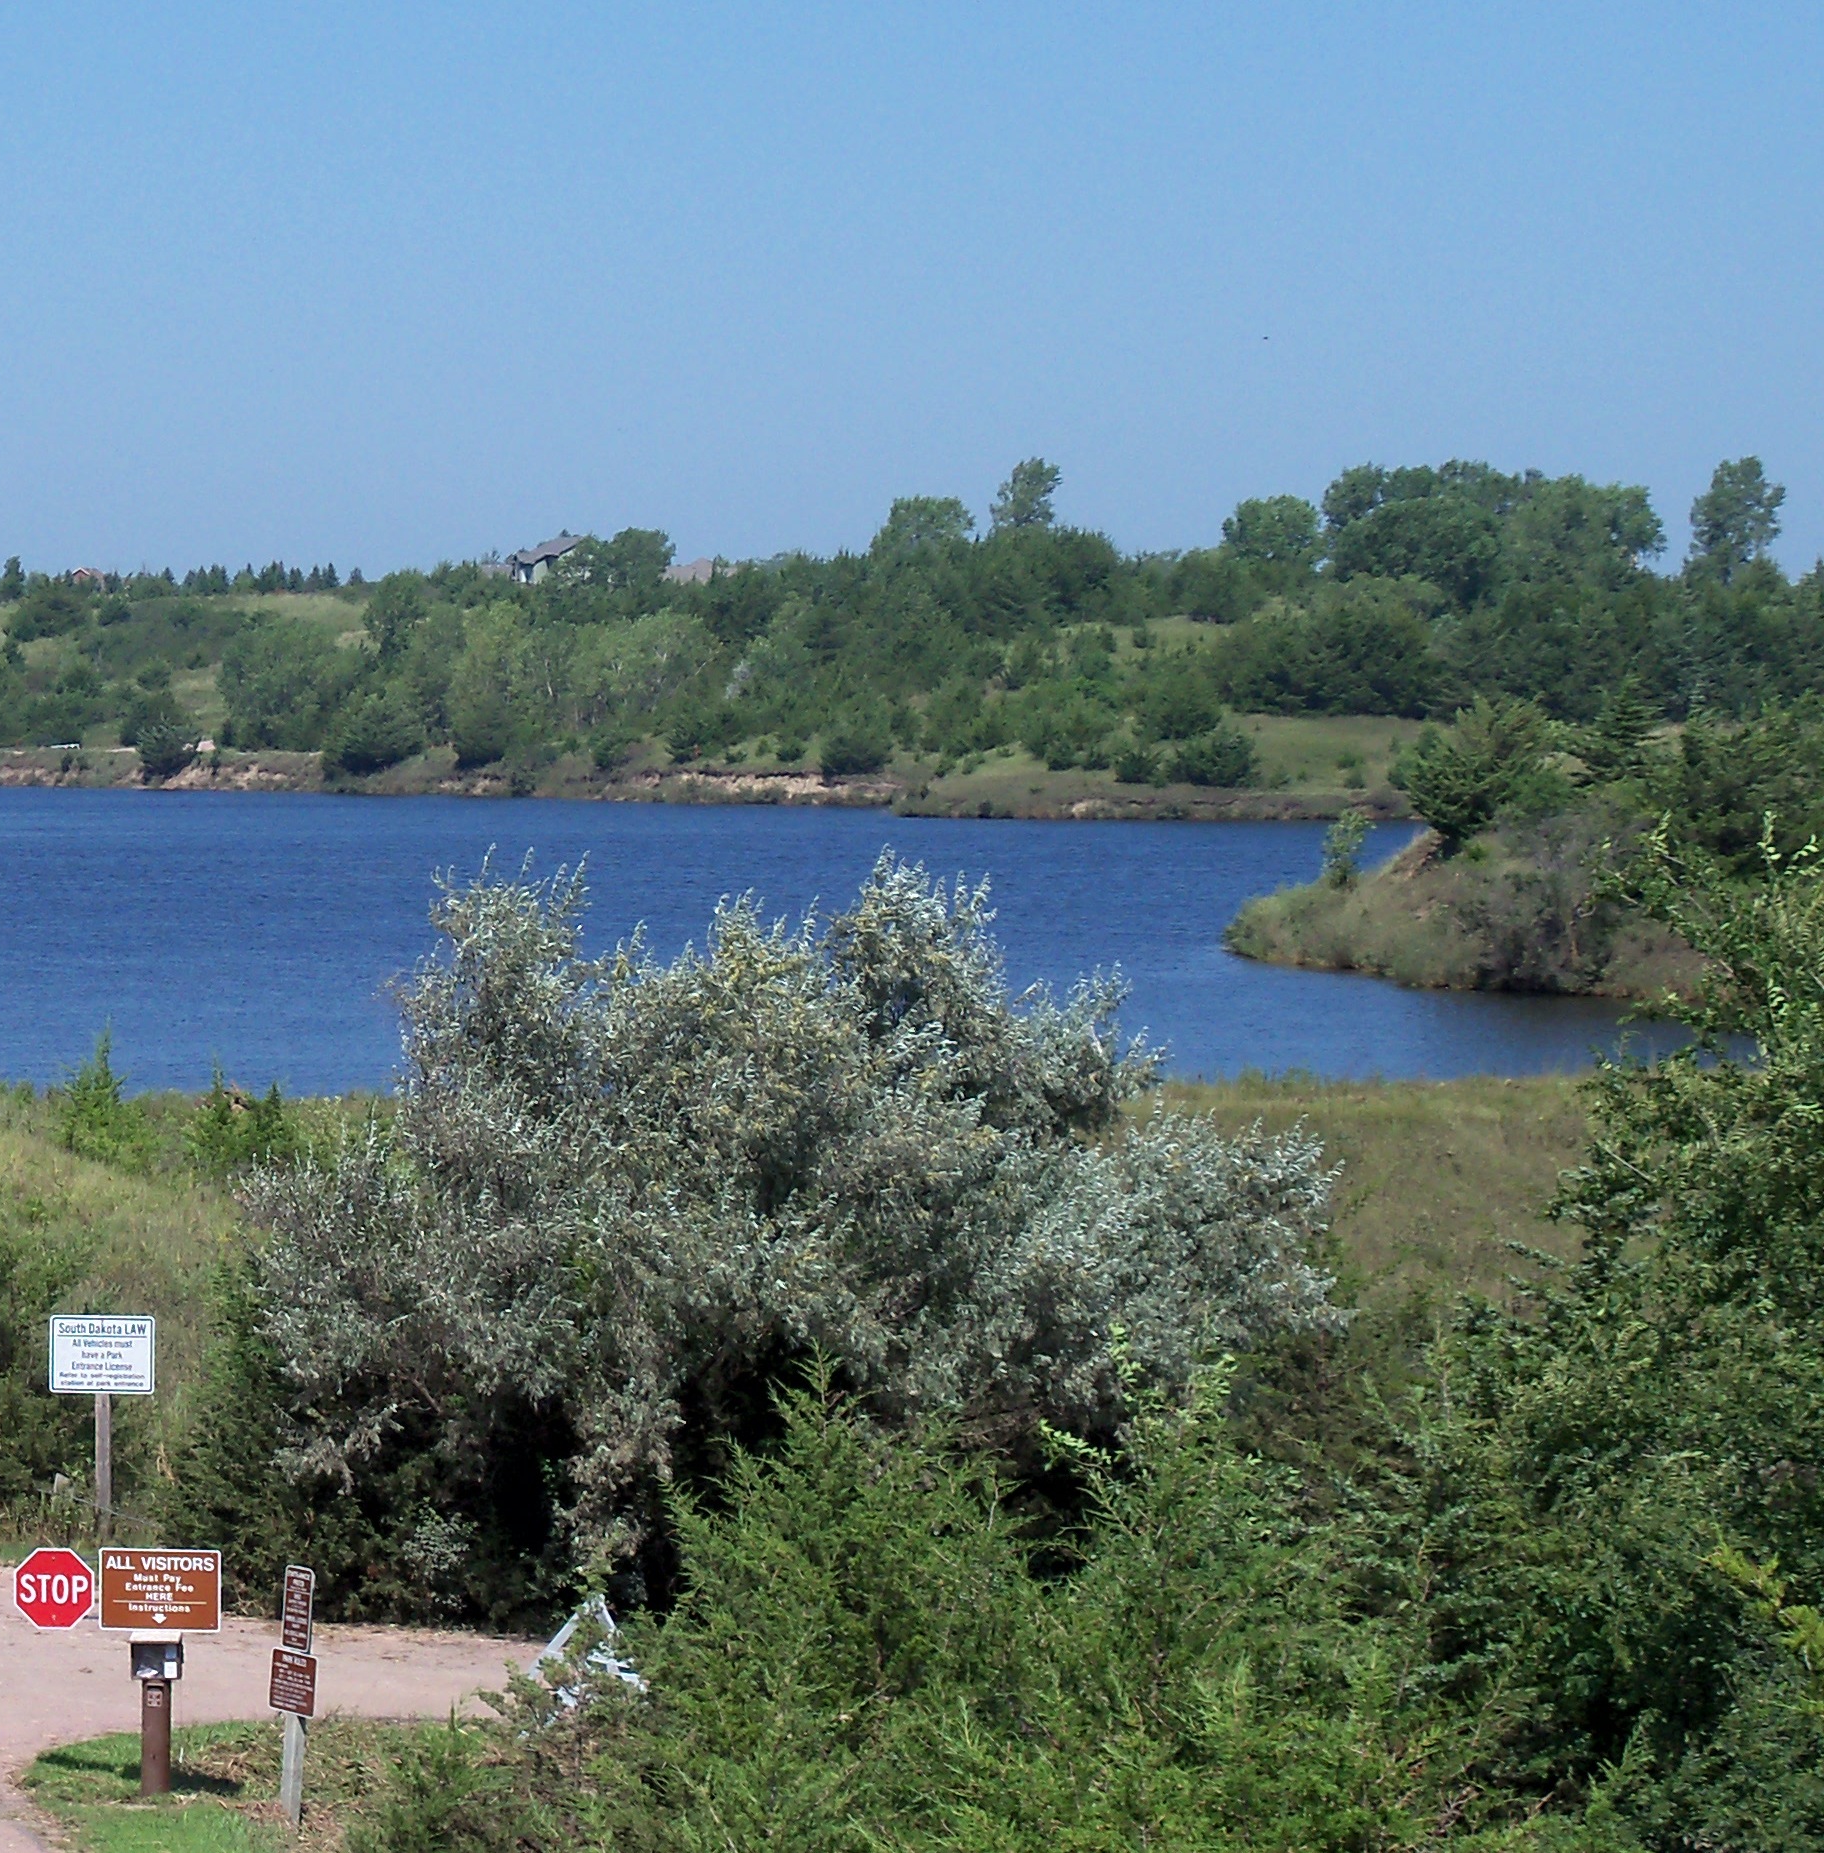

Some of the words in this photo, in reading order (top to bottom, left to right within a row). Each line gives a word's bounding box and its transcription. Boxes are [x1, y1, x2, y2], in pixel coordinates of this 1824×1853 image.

[59, 1323, 86, 1334] South
[89, 1323, 122, 1334] Dakota
[125, 1324, 146, 1334] LAW
[72, 1362, 103, 1370] Entrance
[105, 1362, 132, 1370] License
[106, 1556, 135, 1570] ALL
[141, 1556, 214, 1571] VISITORS
[134, 1574, 158, 1582] Must
[163, 1574, 181, 1583] Pay
[20, 1574, 88, 1604] STOP
[125, 1582, 171, 1591] Entrance
[176, 1583, 194, 1592] Fee
[129, 1603, 191, 1613] Instructions
